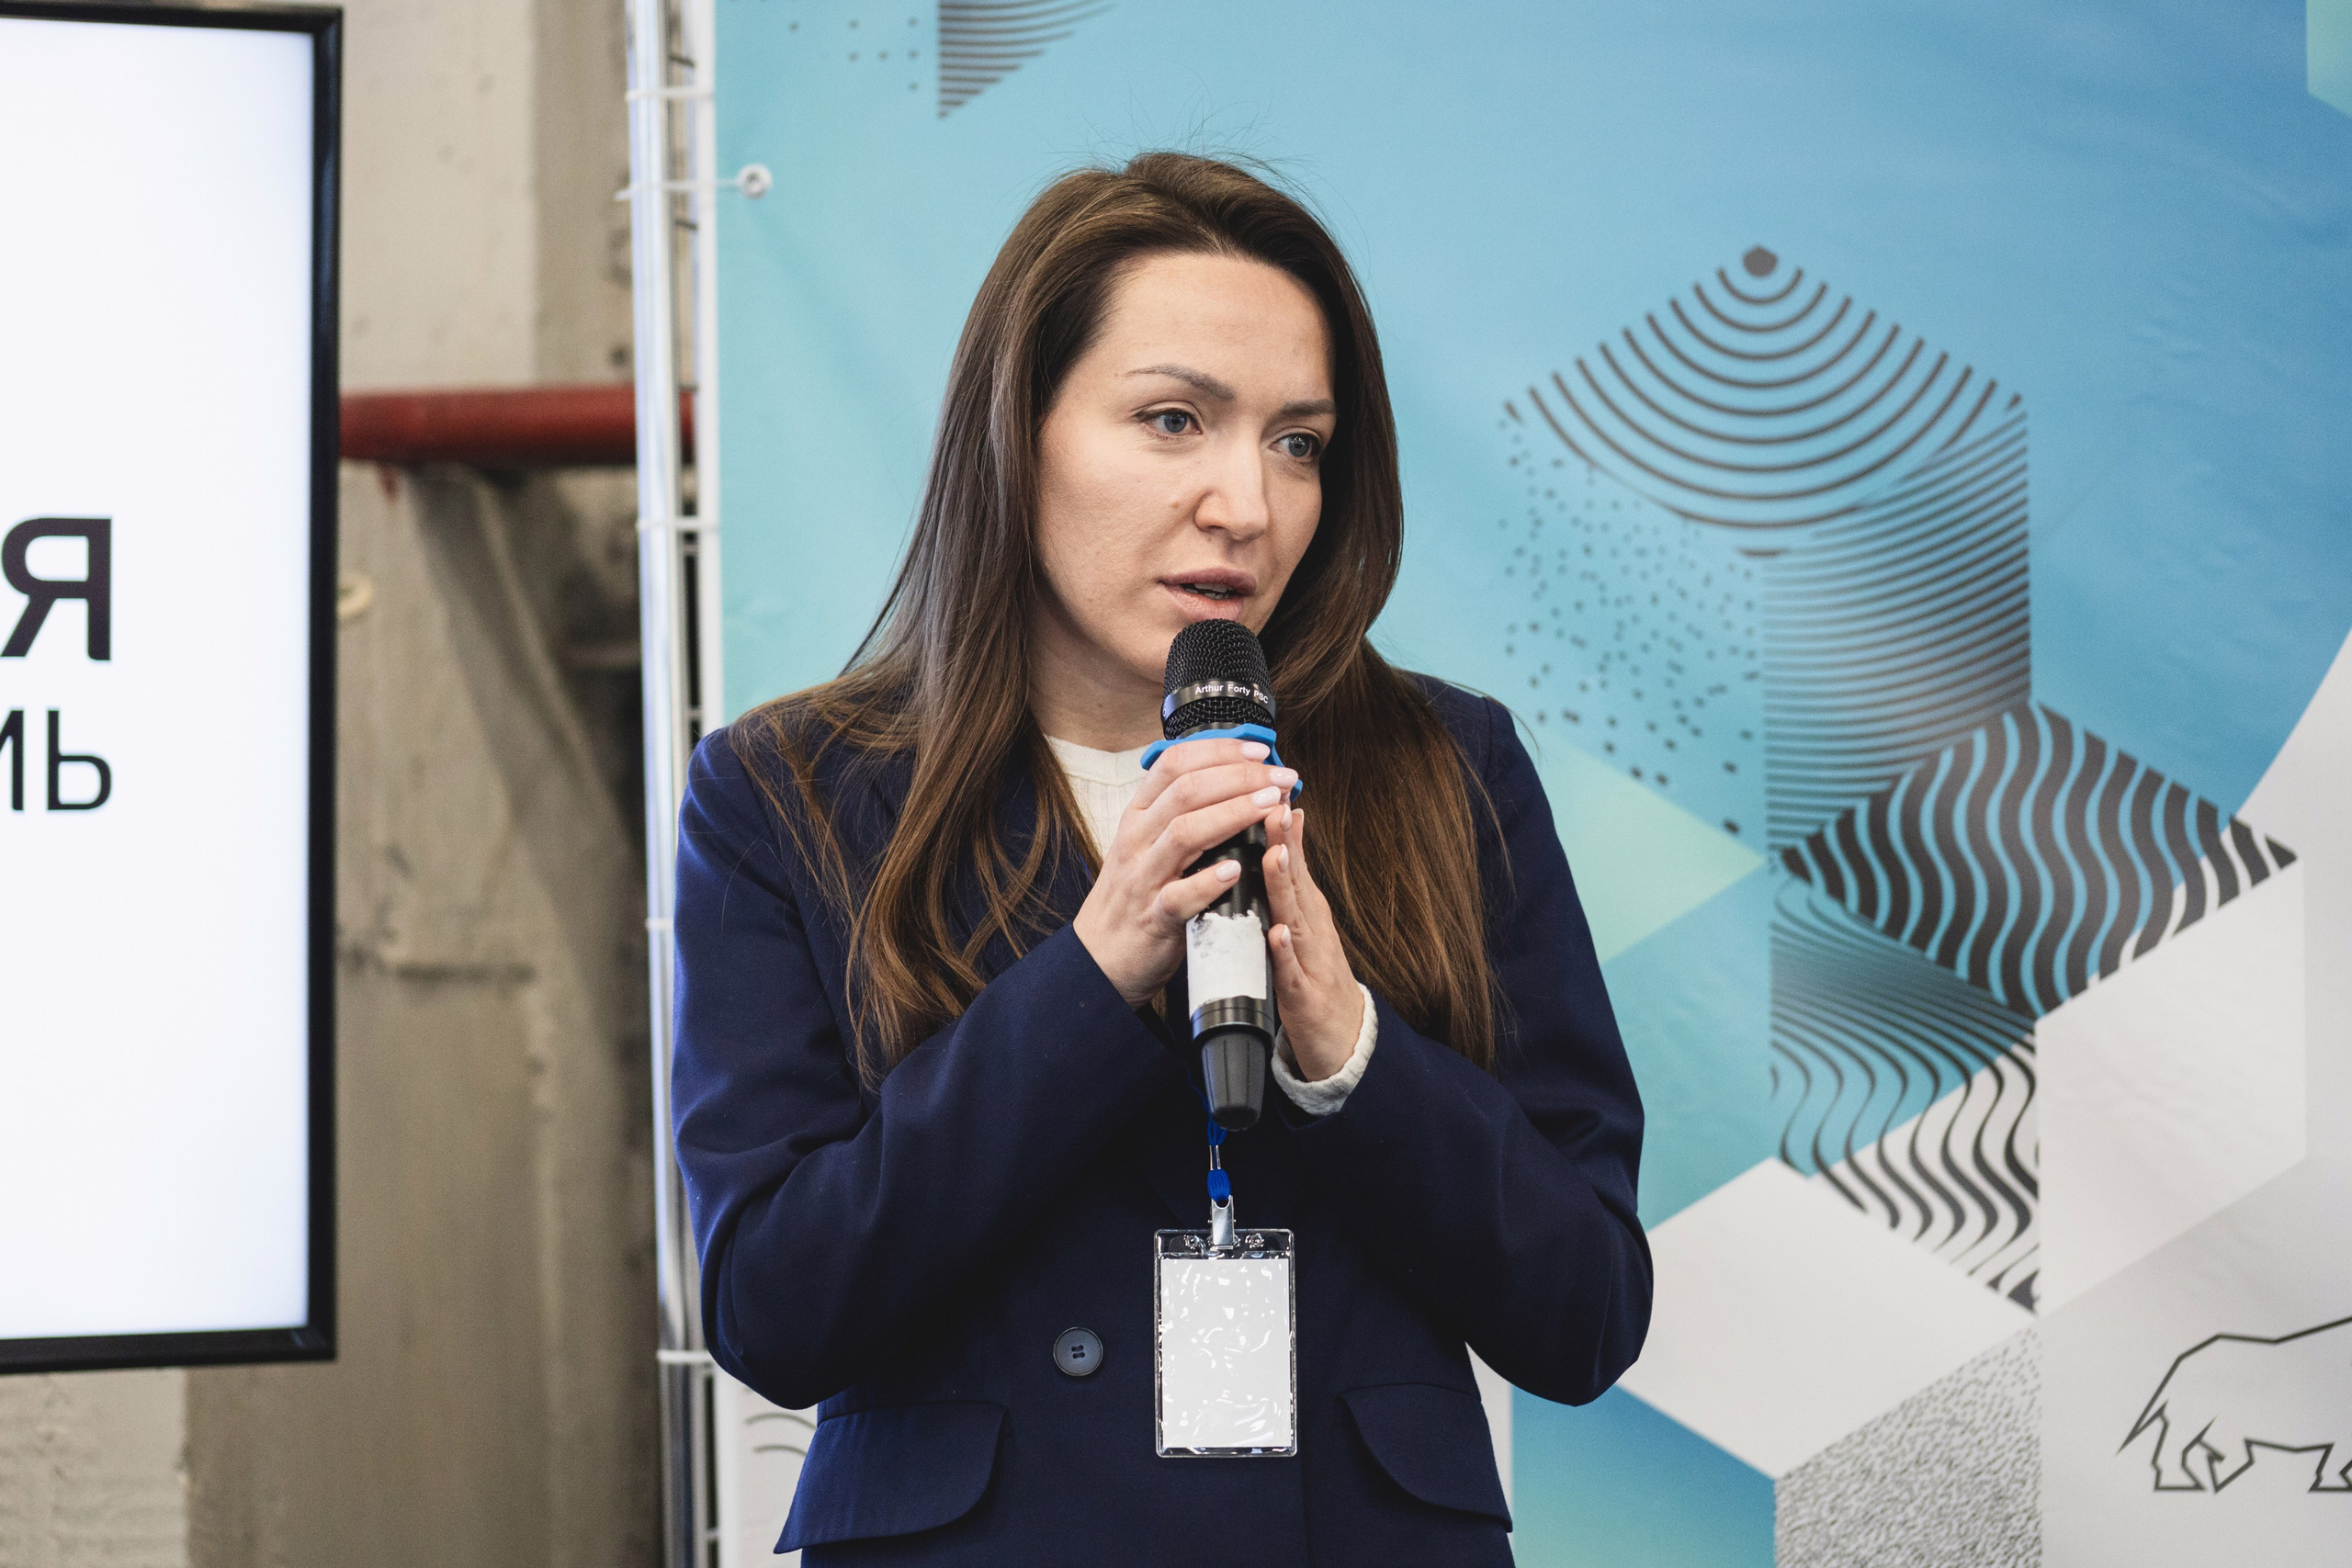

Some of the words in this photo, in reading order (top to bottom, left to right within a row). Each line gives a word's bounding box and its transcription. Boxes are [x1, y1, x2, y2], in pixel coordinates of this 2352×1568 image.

[0, 517, 111, 660] Я
[1195, 684, 1224, 695] Arthur
[1227, 683, 1250, 695] Forty
